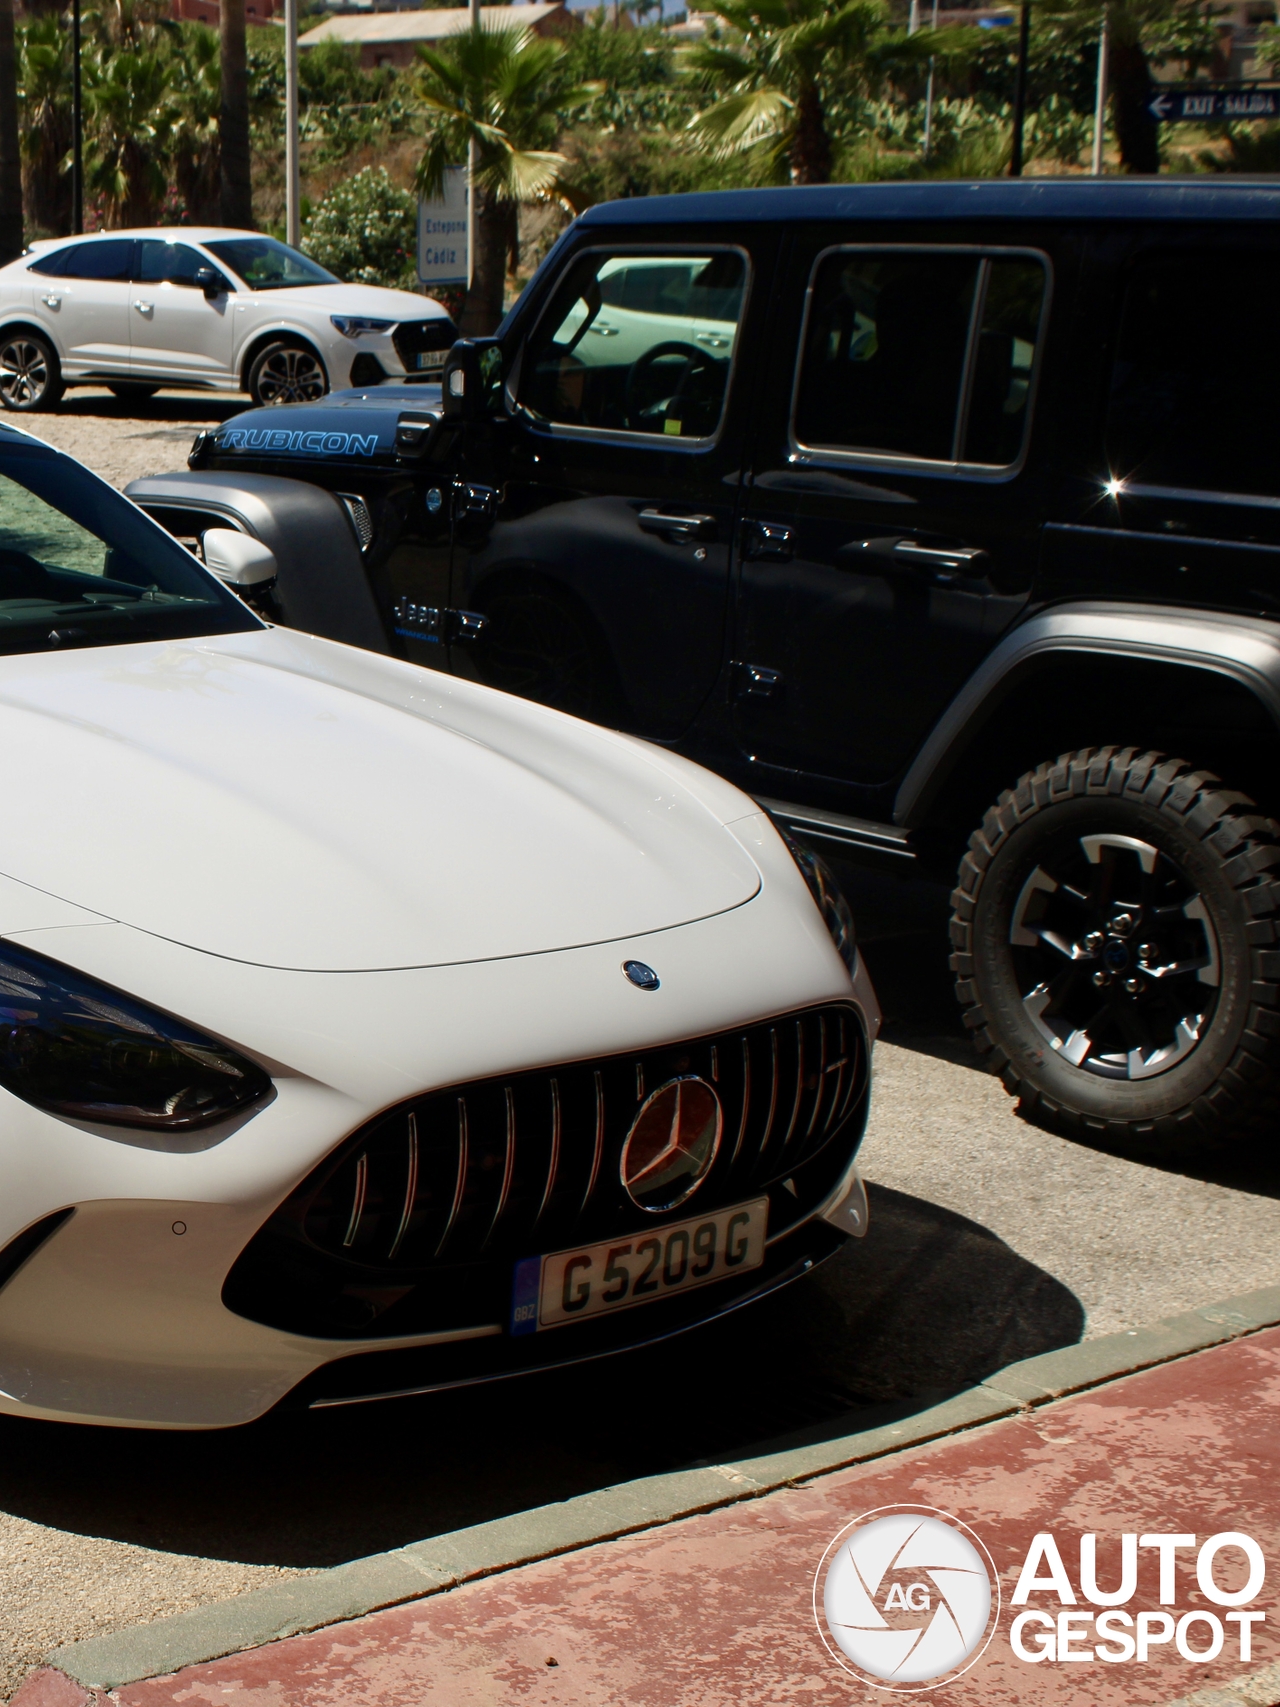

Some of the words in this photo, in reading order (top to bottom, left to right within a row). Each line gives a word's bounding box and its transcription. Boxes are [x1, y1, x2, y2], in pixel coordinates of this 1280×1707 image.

[1182, 95, 1216, 115] EXIT
[1223, 94, 1275, 114] SALIDA
[426, 219, 467, 235] Estepona
[222, 429, 378, 456] RUBICON
[394, 596, 439, 630] Jeep
[514, 1304, 535, 1321] GBZ
